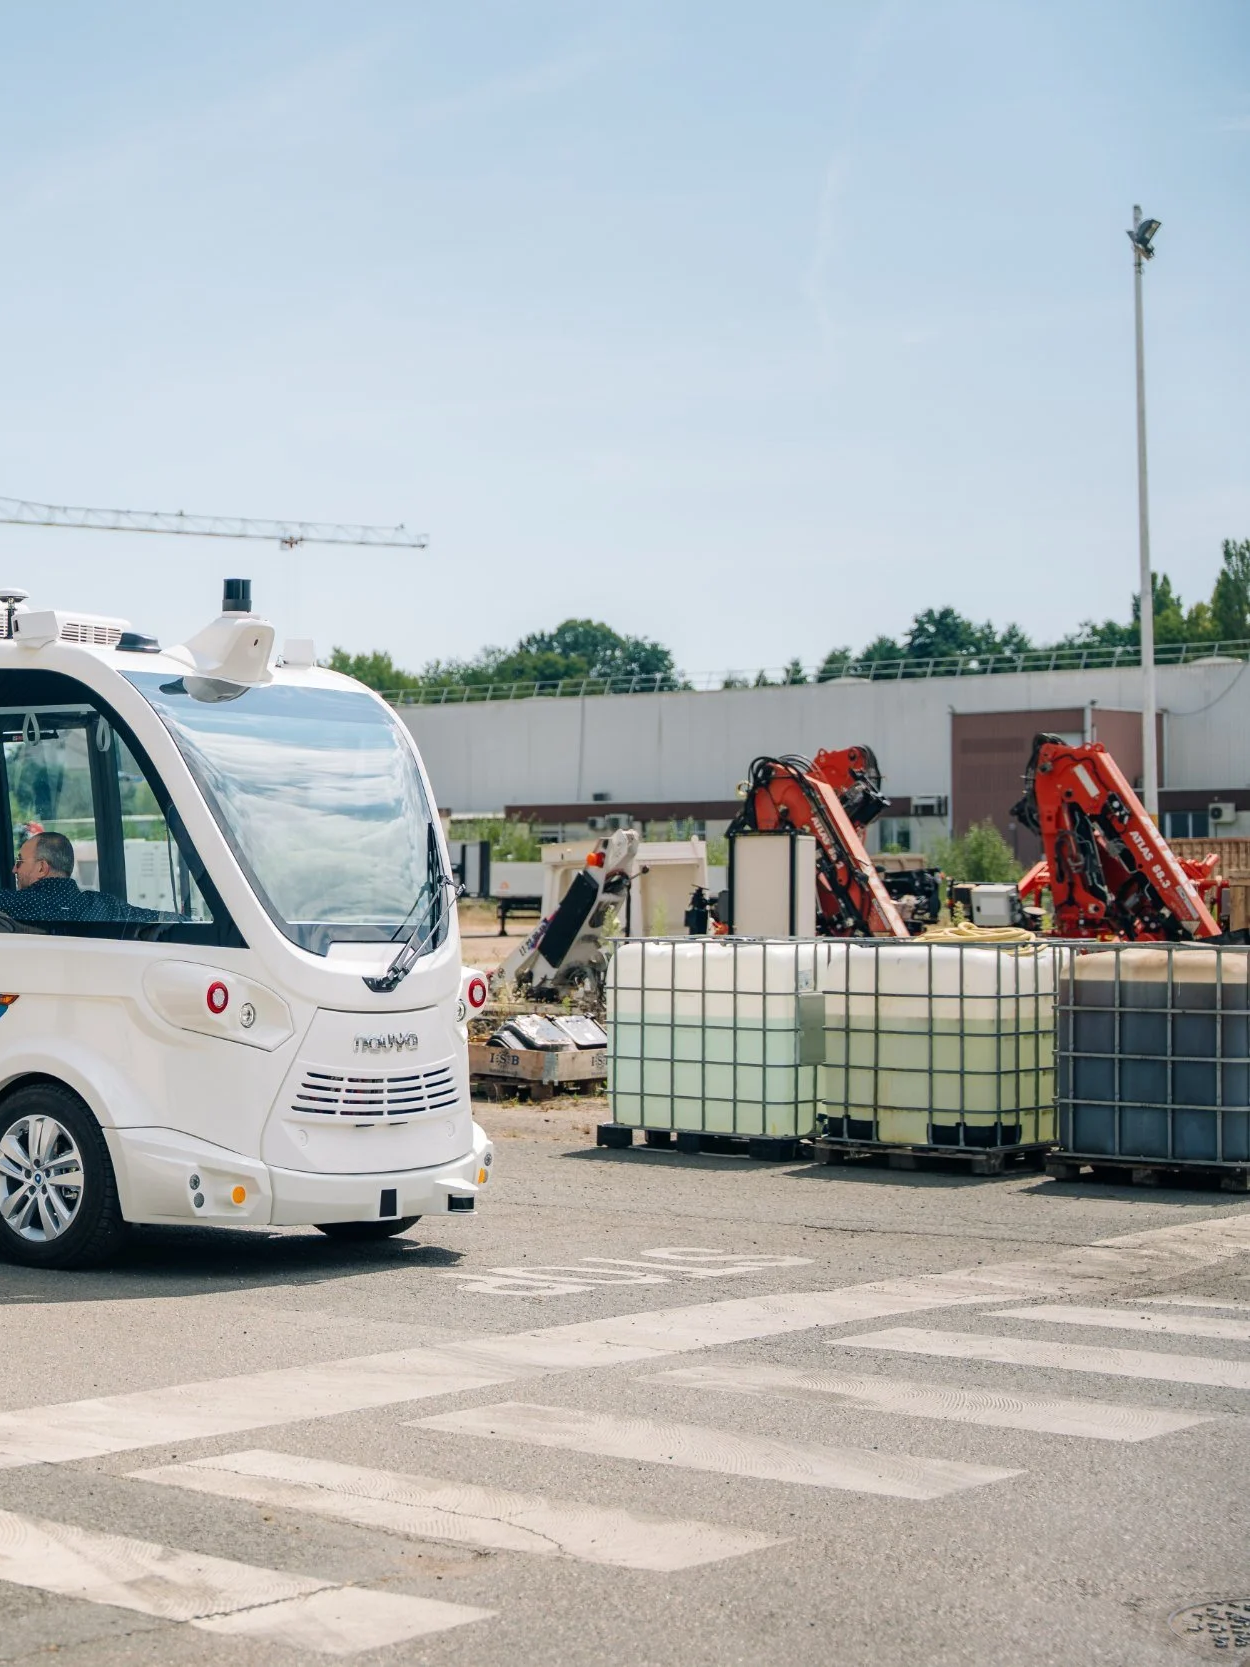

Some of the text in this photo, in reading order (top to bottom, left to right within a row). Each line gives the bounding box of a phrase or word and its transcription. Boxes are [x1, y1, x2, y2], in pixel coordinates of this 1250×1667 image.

[810, 817, 831, 845] ATLAS
[1130, 831, 1171, 888] ATLAS 88.3
[353, 1031, 418, 1054] navya
[431, 1247, 814, 1296] STOP
